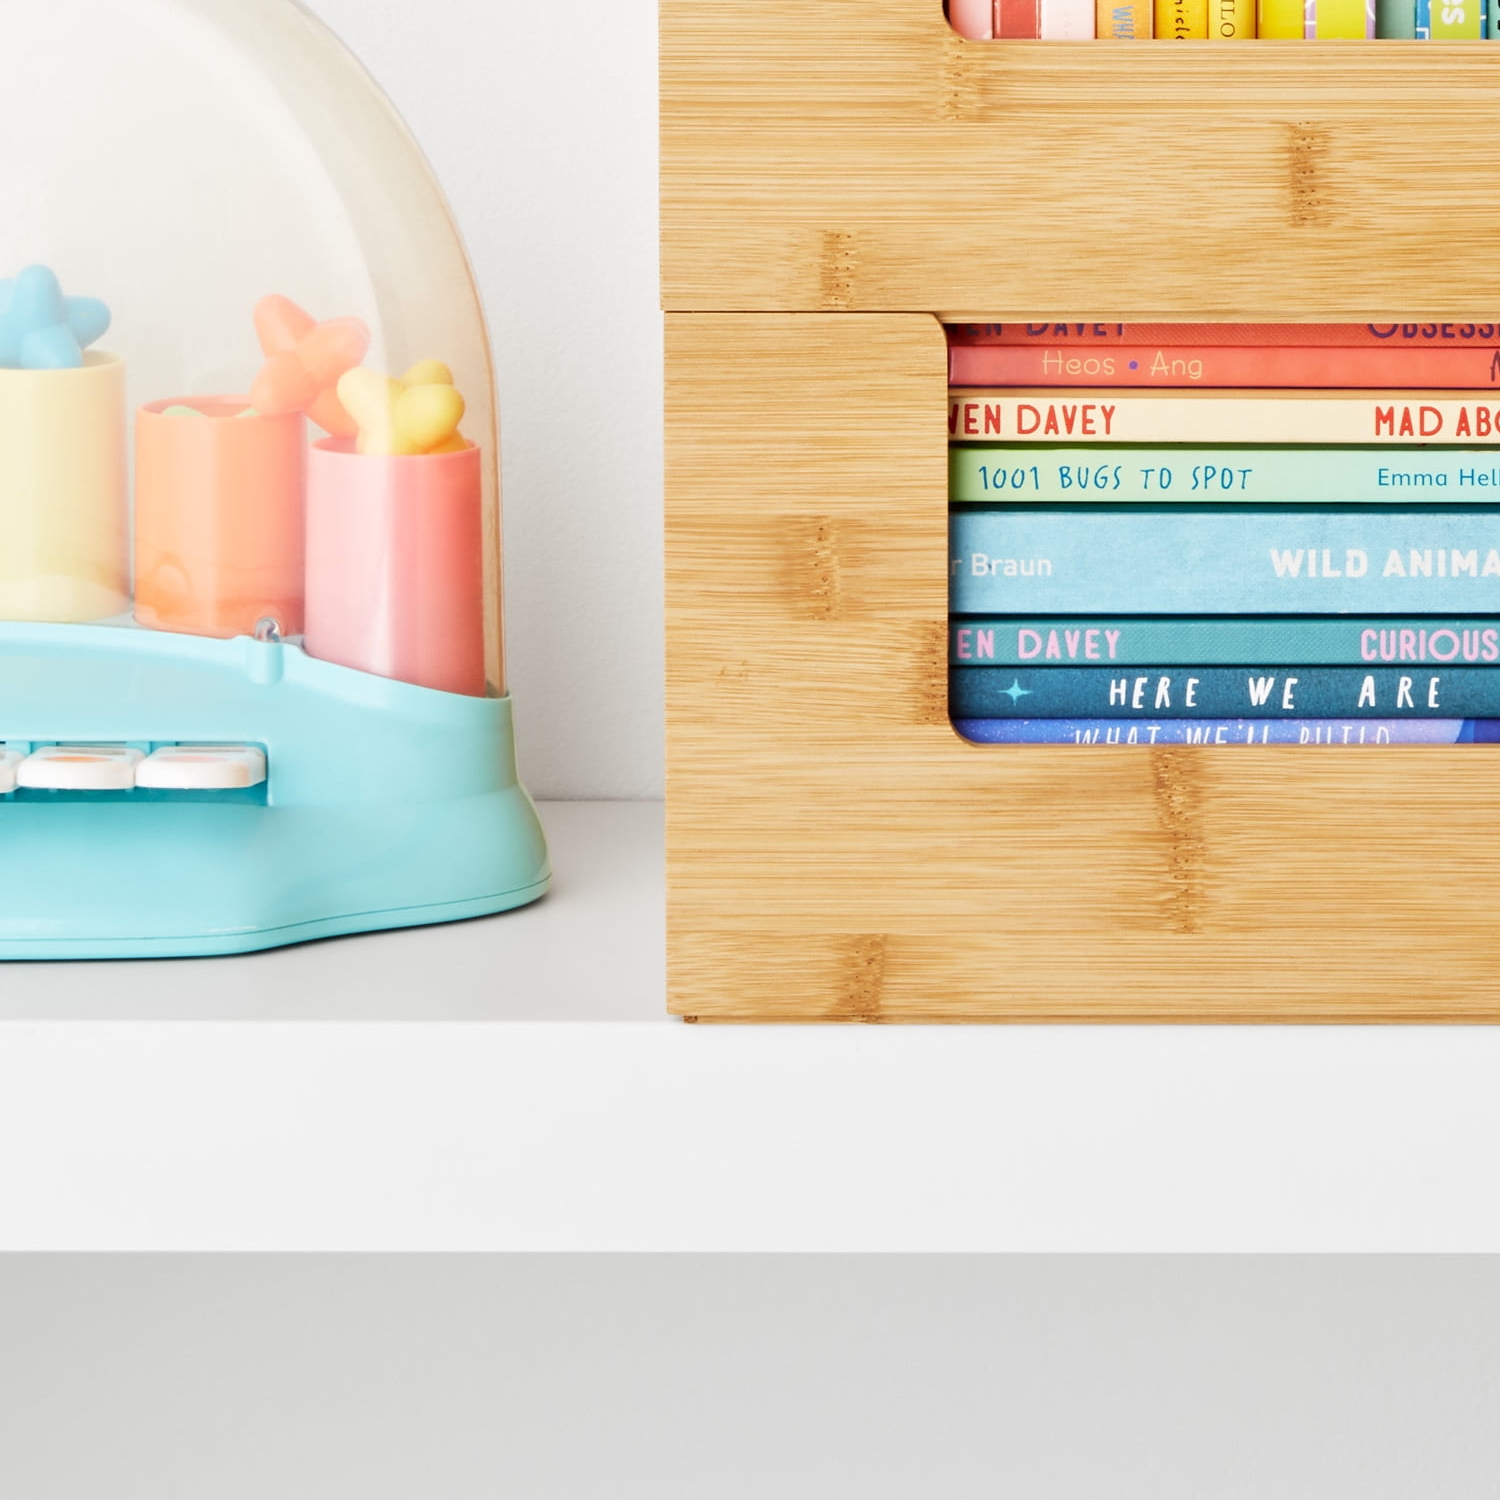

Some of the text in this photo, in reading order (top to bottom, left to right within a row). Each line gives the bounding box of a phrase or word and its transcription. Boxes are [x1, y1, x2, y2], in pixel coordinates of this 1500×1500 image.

[1042, 353, 1203, 379] Heos Ang
[1017, 404, 1116, 435] DAVEY
[1374, 406, 1443, 437] MAD
[979, 465, 1253, 490] 1001 BUGS TO SPOT
[1377, 468, 1448, 487] Emma
[971, 553, 1052, 577] Braun
[1270, 550, 1368, 578] WILD
[1018, 629, 1120, 659] DAVEY
[1360, 629, 1498, 662] CURIOUS
[1109, 675, 1441, 708] HERE WE ARE
